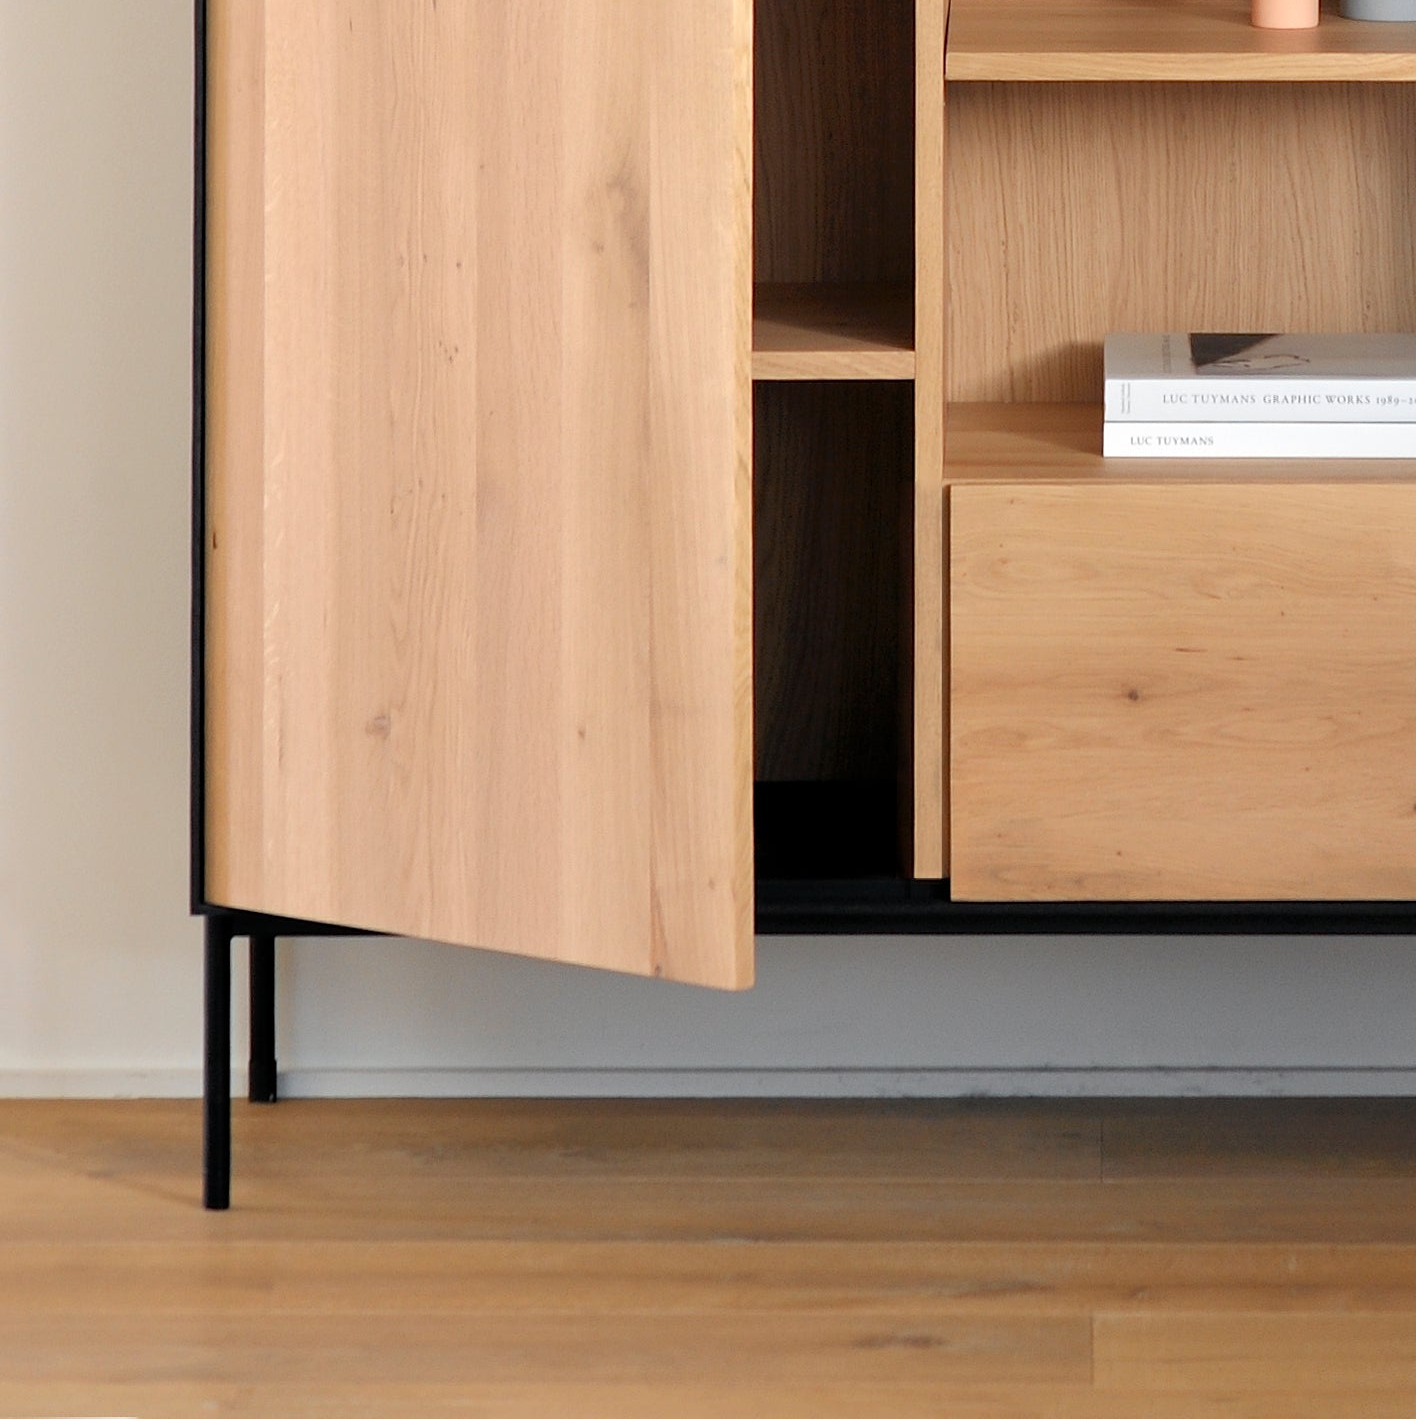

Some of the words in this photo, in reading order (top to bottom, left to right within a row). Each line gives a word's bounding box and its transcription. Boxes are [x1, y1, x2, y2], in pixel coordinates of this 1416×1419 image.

[1162, 394, 1188, 405] LUC
[1191, 394, 1257, 405] TUYMANS
[1262, 394, 1321, 405] GRAPHIC
[1325, 394, 1372, 405] WORKS
[1130, 436, 1153, 446] LUC
[1157, 436, 1214, 446] TUYMANS
